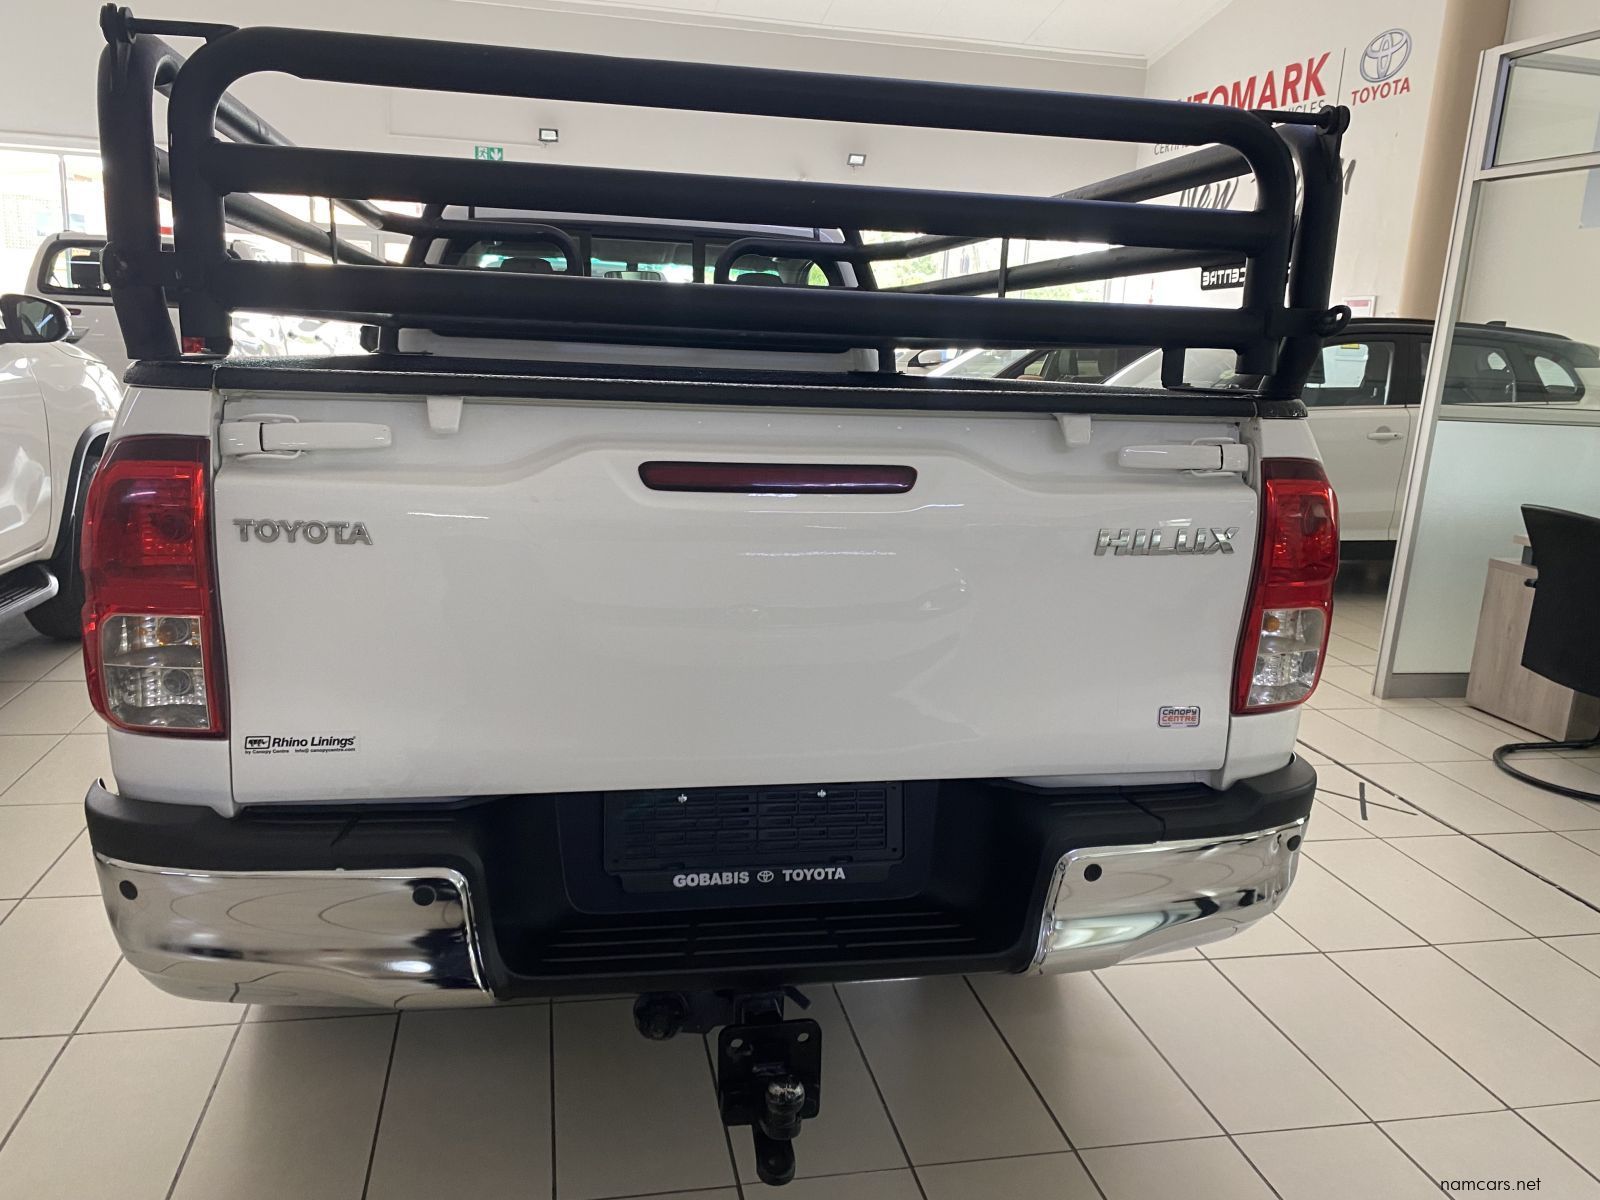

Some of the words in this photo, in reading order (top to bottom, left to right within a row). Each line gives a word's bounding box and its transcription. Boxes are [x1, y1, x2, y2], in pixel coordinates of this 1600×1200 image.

[1184, 51, 1331, 111] TOMARK
[1351, 77, 1411, 106] TOYOTA
[232, 518, 374, 545] TOYOTA
[1094, 526, 1240, 556] HILUX
[272, 737, 308, 748] Rhino
[672, 871, 750, 888] GOBABIS
[782, 867, 846, 882] TOYOTA
